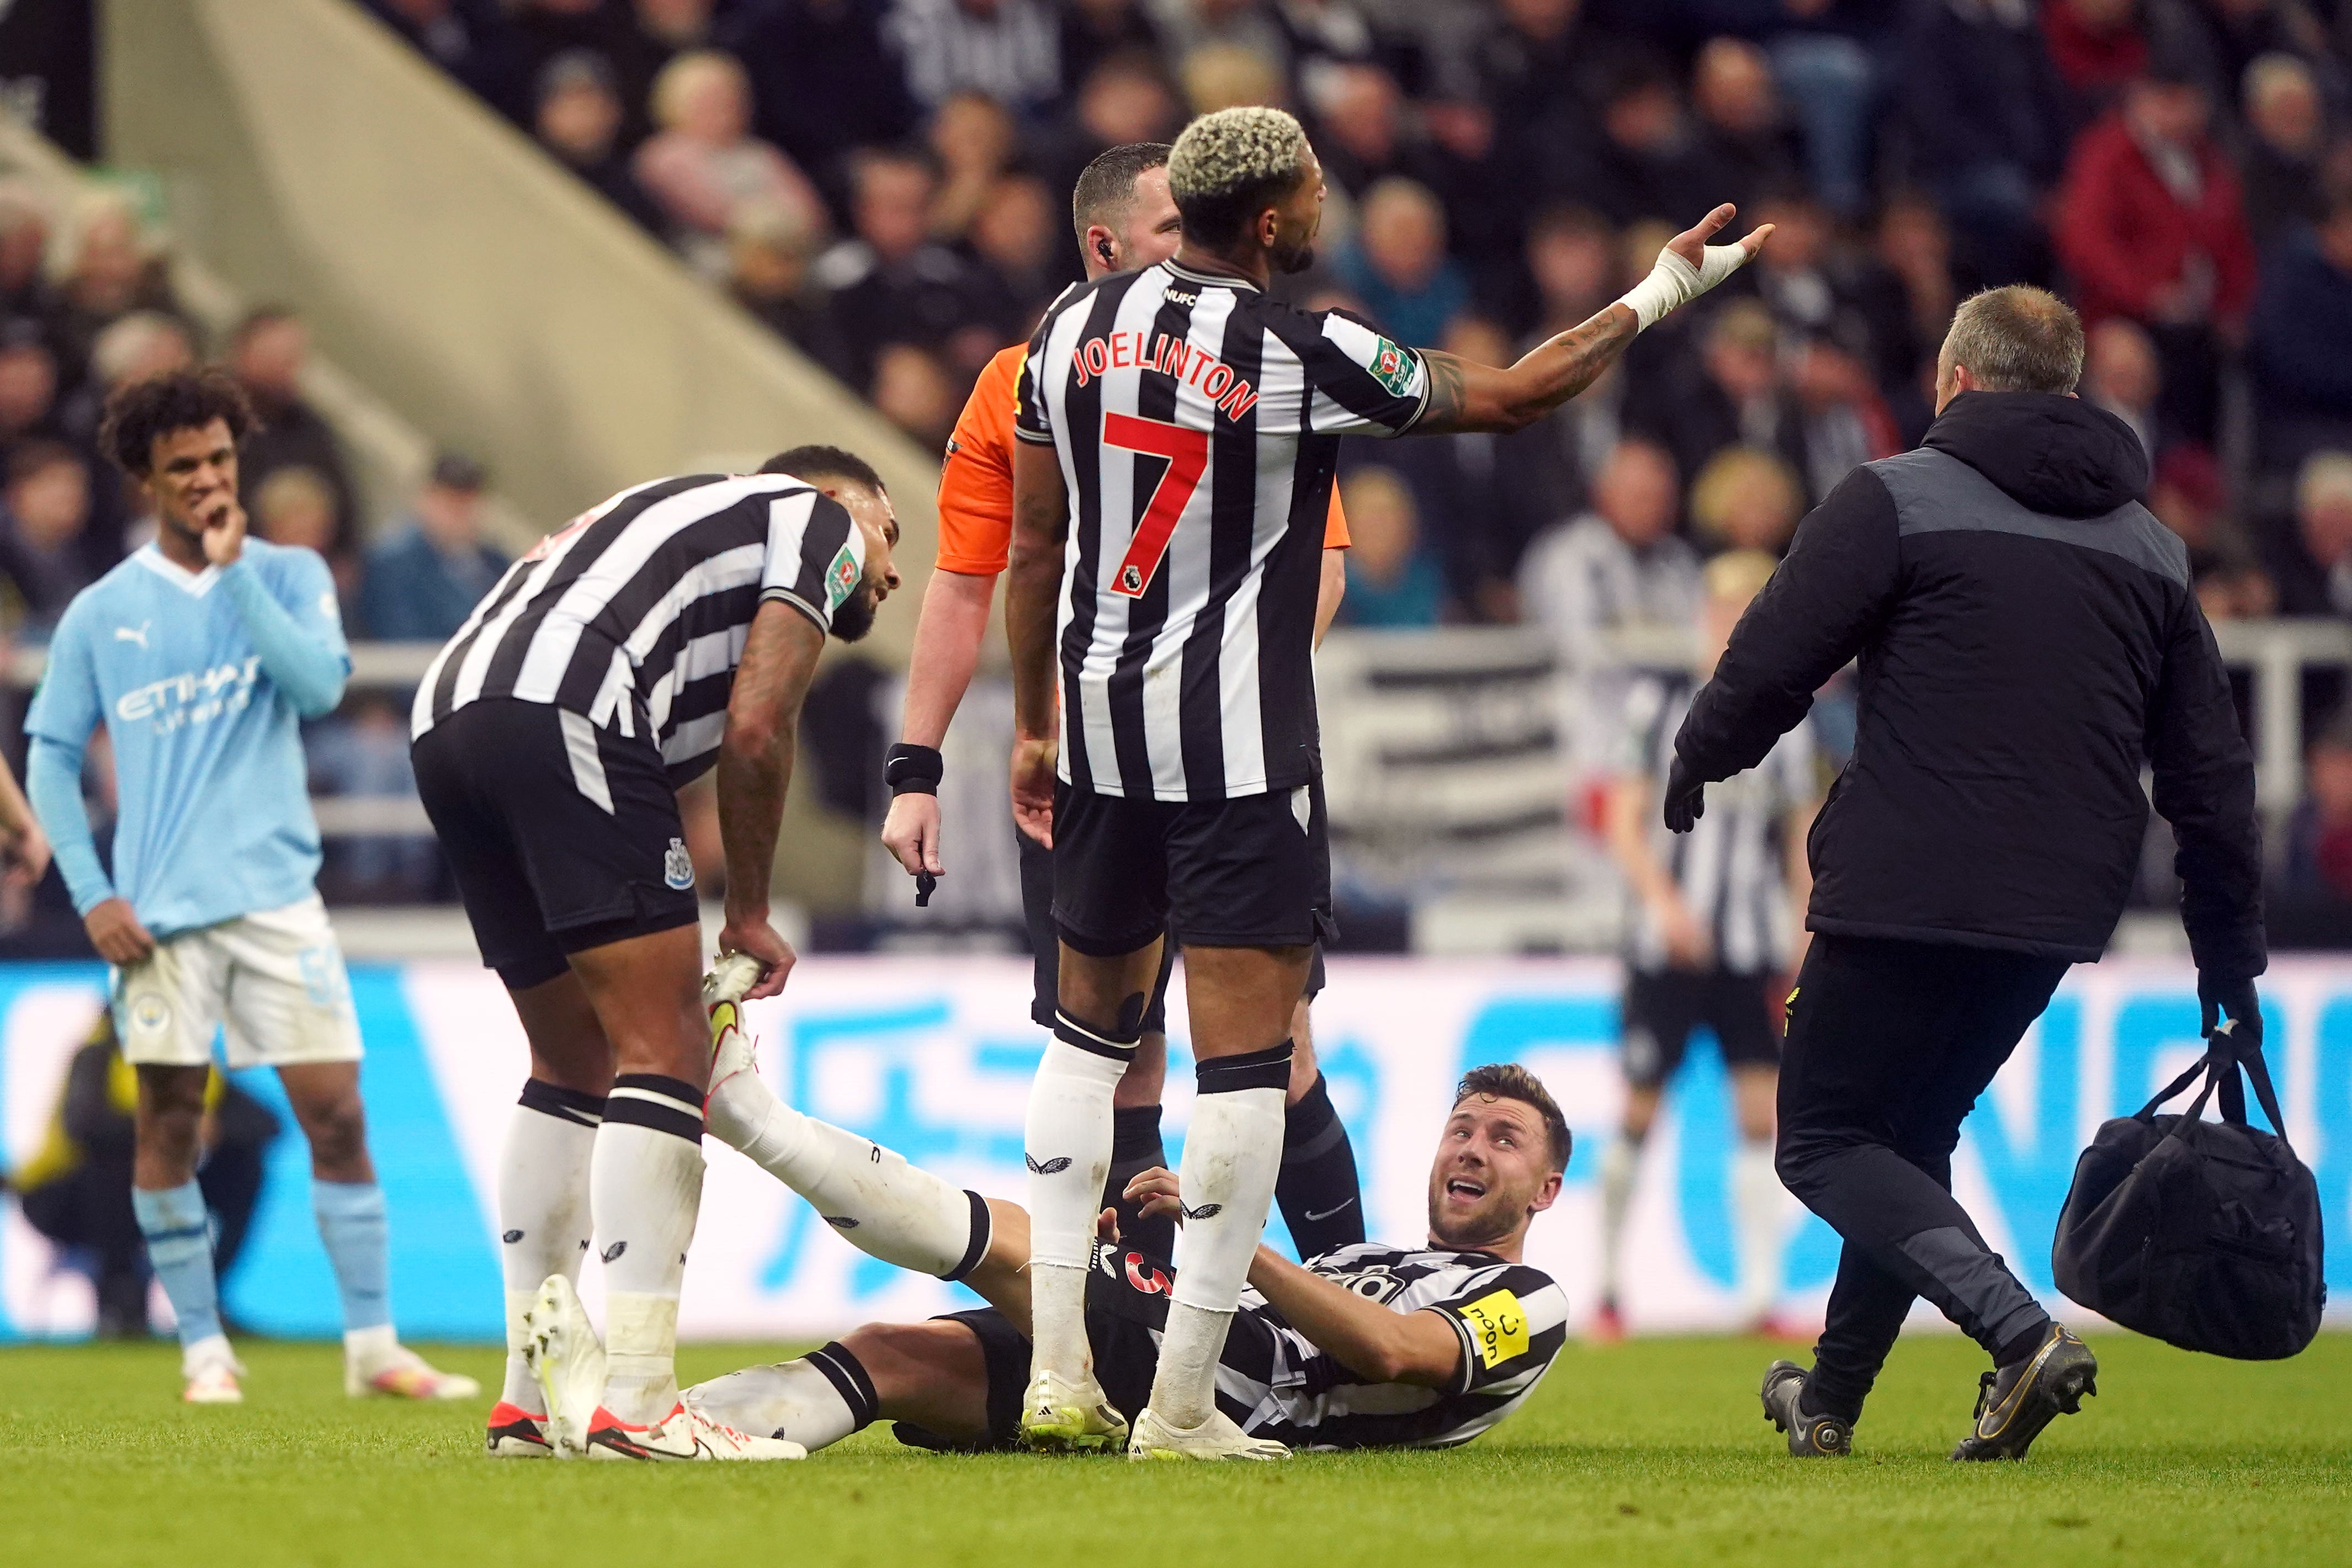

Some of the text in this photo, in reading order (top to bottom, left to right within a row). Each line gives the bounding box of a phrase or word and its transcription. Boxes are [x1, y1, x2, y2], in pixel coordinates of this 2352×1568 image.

[1163, 288, 1197, 307] NUFC
[1073, 332, 1259, 423] JOELINTON
[1103, 411, 1209, 599] 7
[1470, 1307, 1497, 1360] noon
